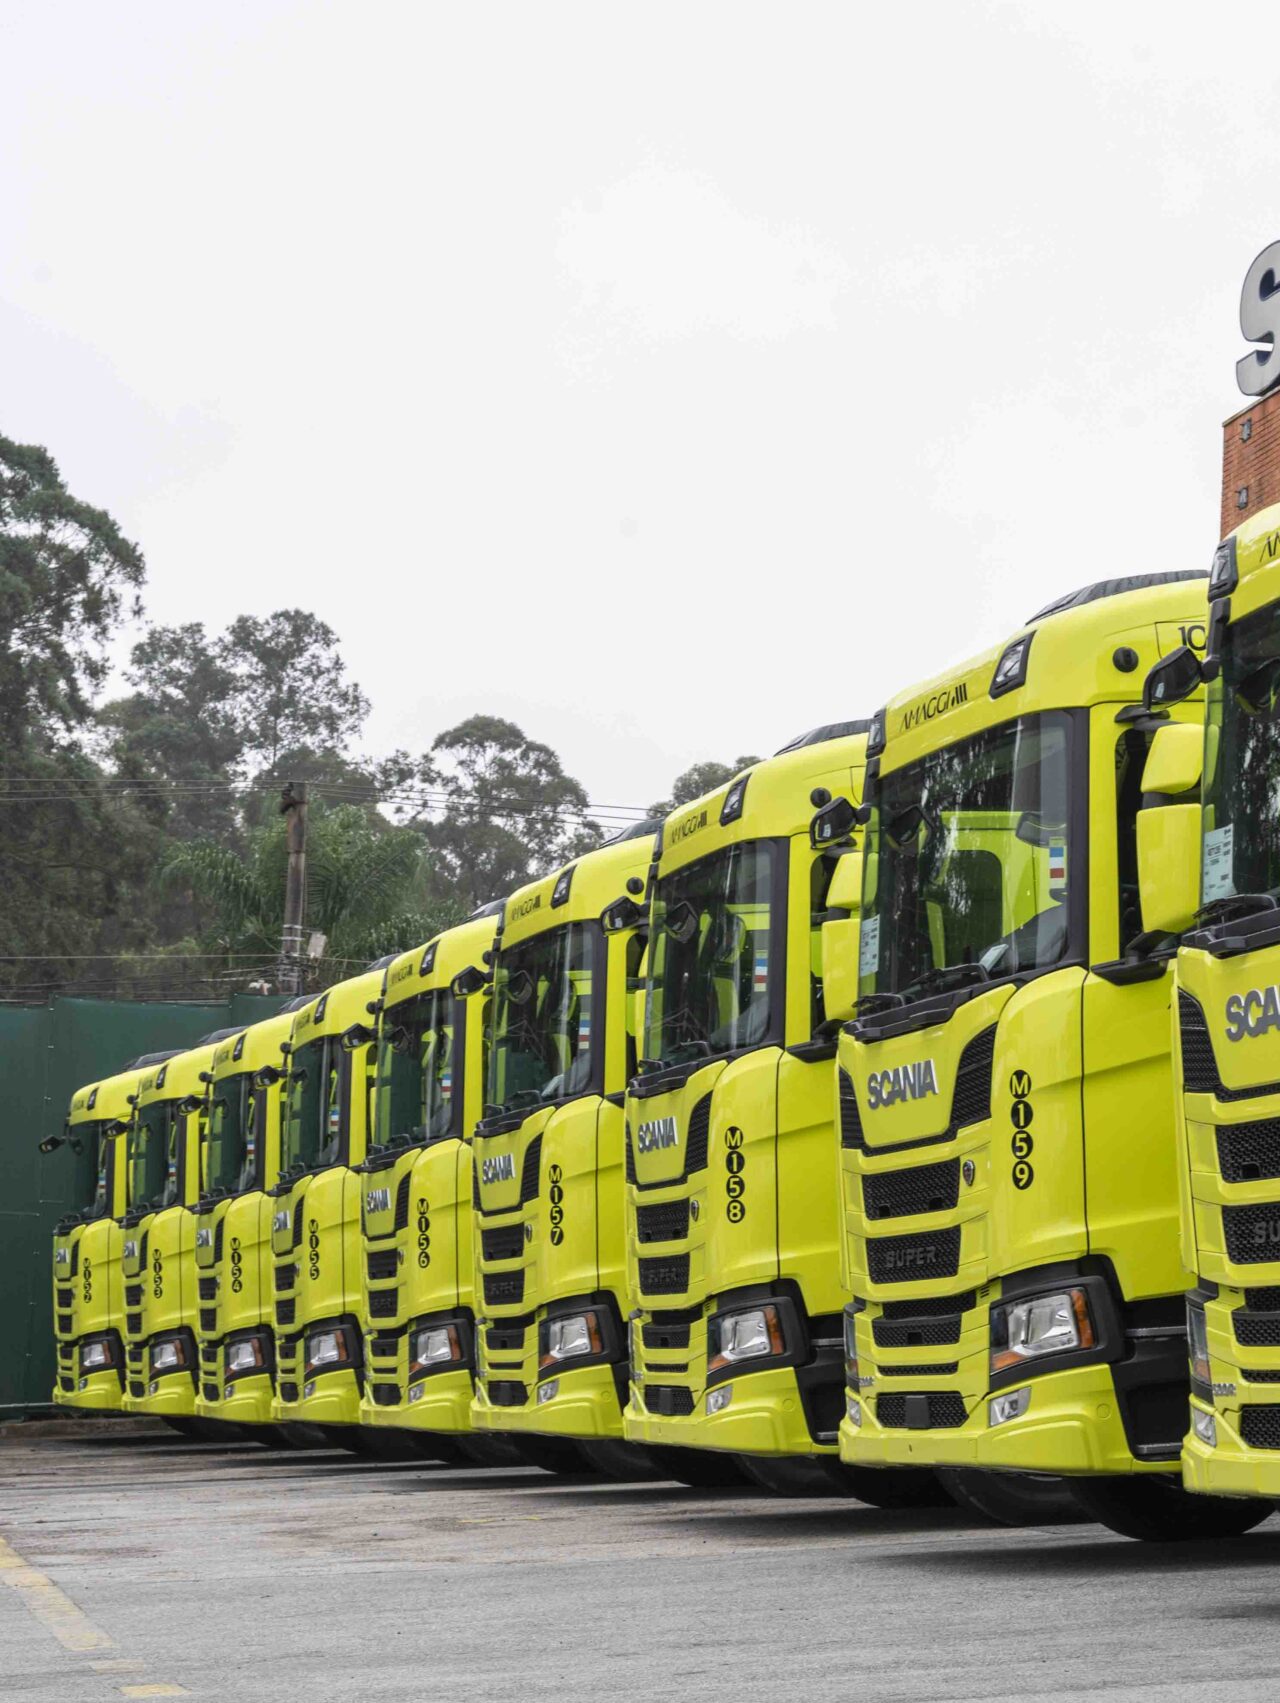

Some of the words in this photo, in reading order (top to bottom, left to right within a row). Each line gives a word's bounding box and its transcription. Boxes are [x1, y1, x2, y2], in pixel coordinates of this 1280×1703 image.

[867, 1058, 939, 1110] SCANIA
[637, 1116, 678, 1154] SCANIA
[885, 1245, 936, 1269] SUPER
